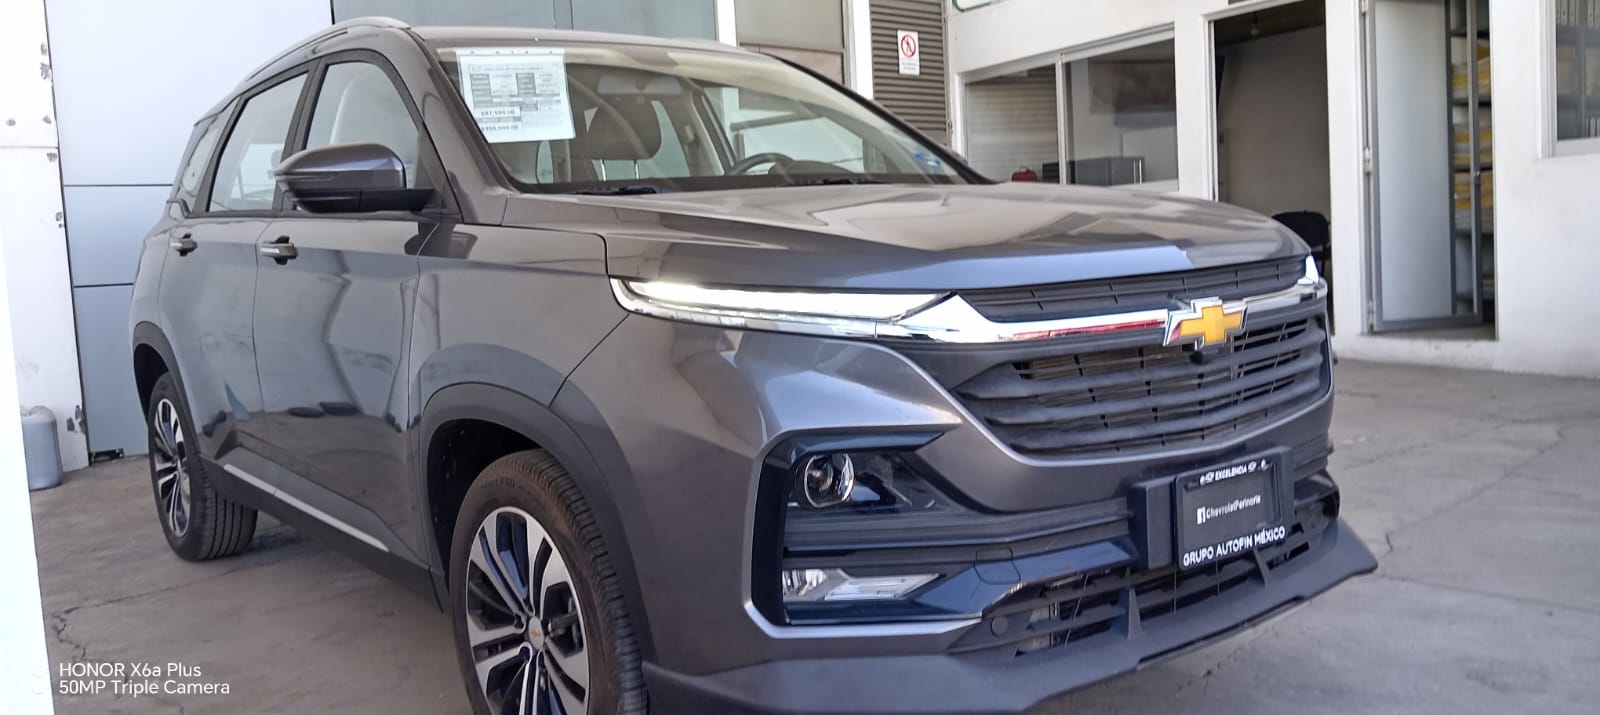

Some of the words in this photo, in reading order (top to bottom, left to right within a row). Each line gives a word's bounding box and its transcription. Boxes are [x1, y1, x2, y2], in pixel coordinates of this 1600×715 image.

[1215, 464, 1247, 481] EXCELENCIA
[1183, 546, 1214, 567] GRUPO
[1216, 534, 1253, 558] AUTOFIN
[1254, 526, 1286, 545] MÉXICO
